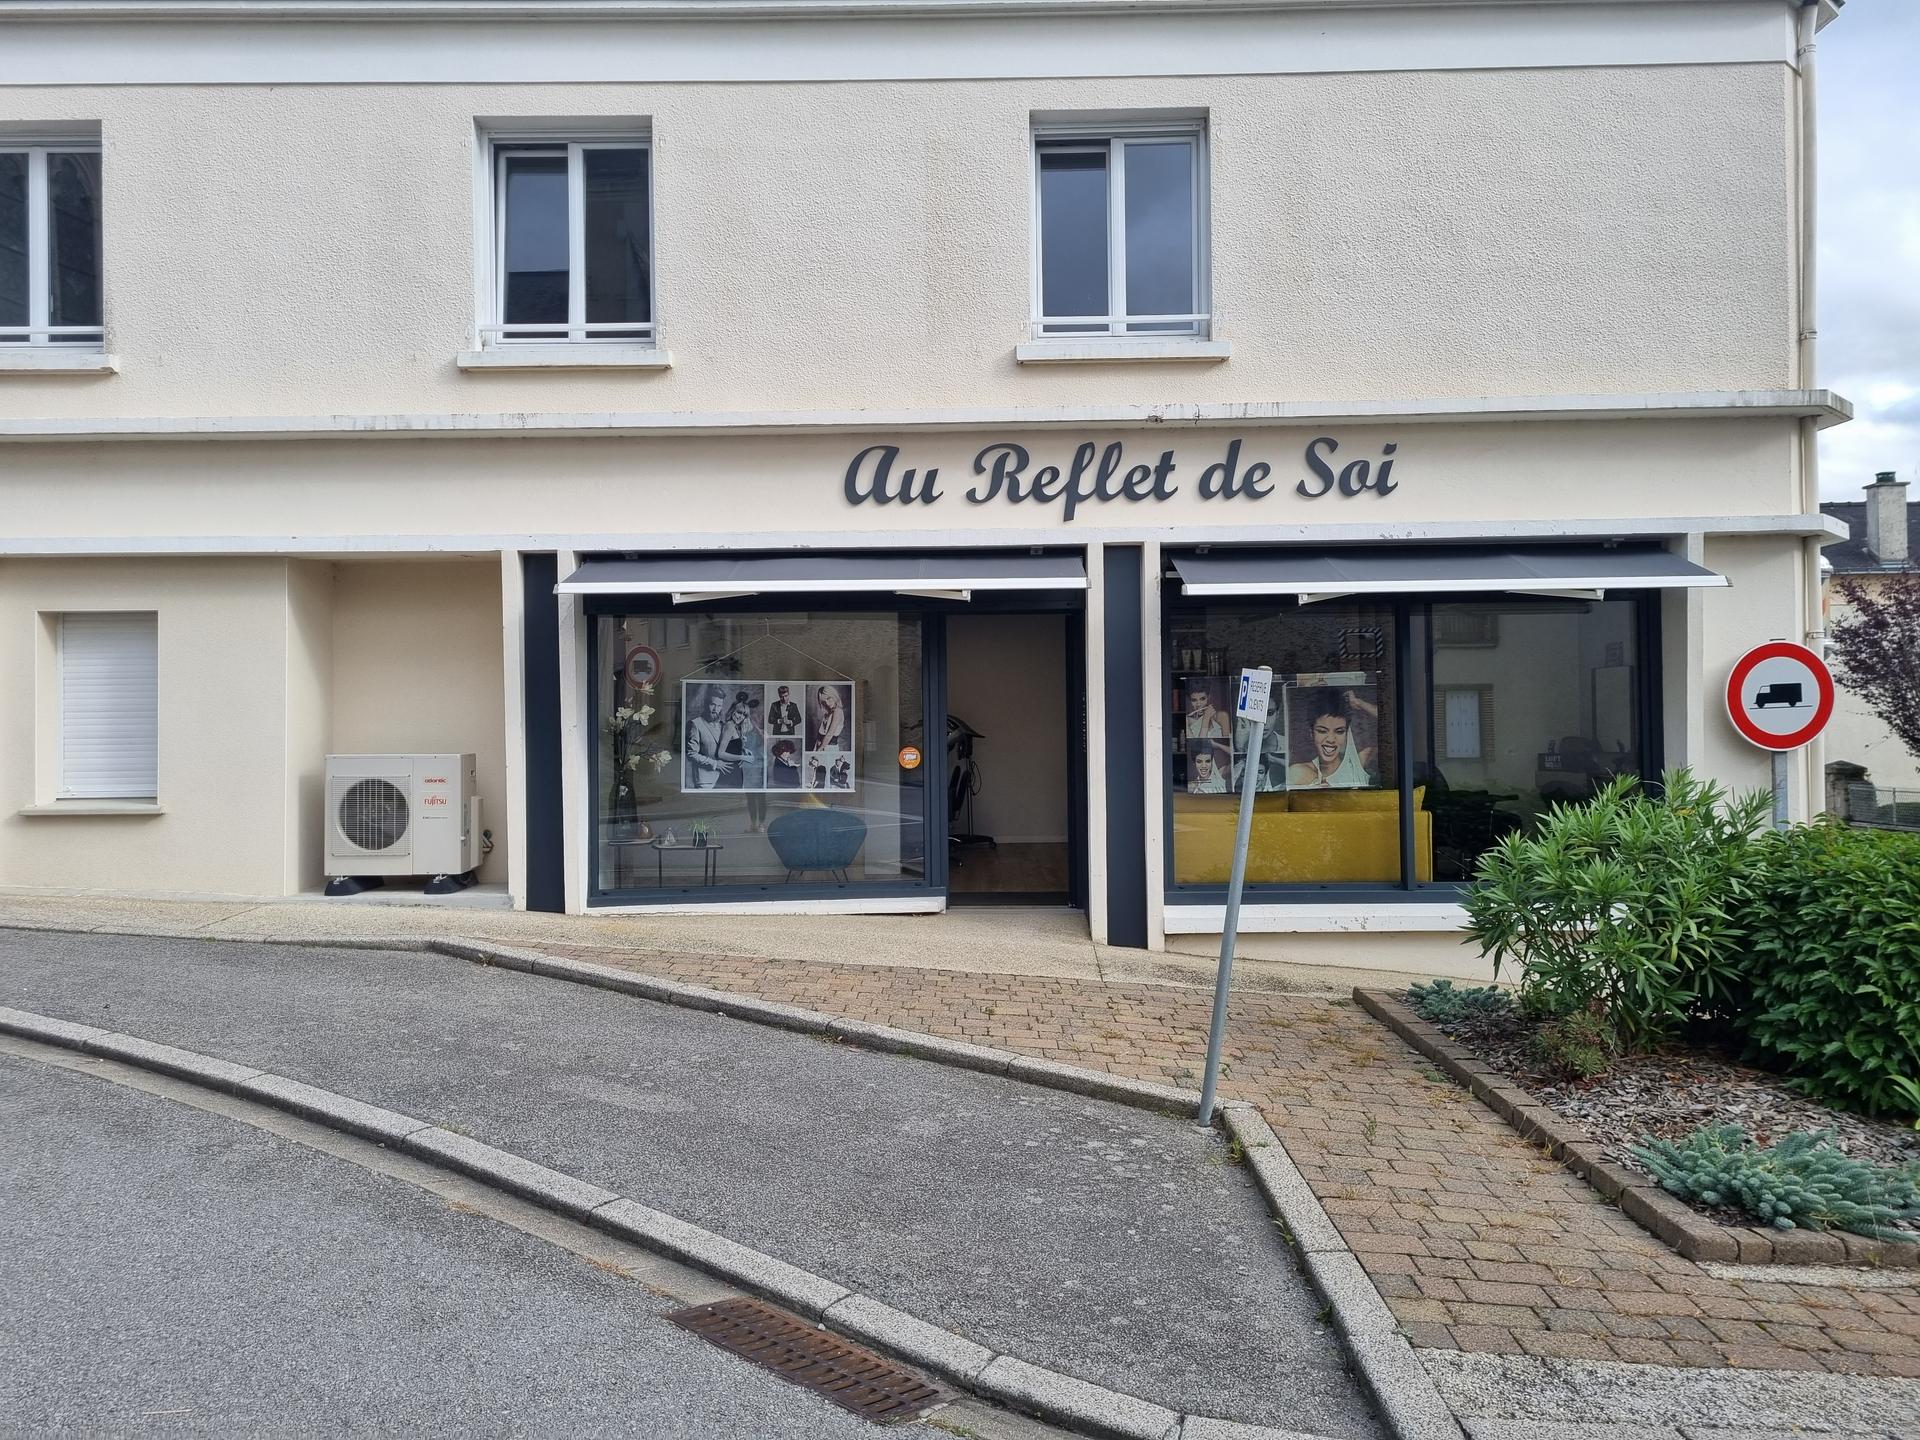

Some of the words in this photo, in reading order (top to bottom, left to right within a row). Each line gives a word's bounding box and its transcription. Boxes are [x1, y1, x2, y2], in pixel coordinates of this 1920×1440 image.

[844, 445, 944, 505] Au
[966, 441, 1179, 522] Reflet
[1198, 438, 1275, 500] de
[1296, 437, 1399, 497] Soi
[424, 795, 447, 806] FUJITSU
